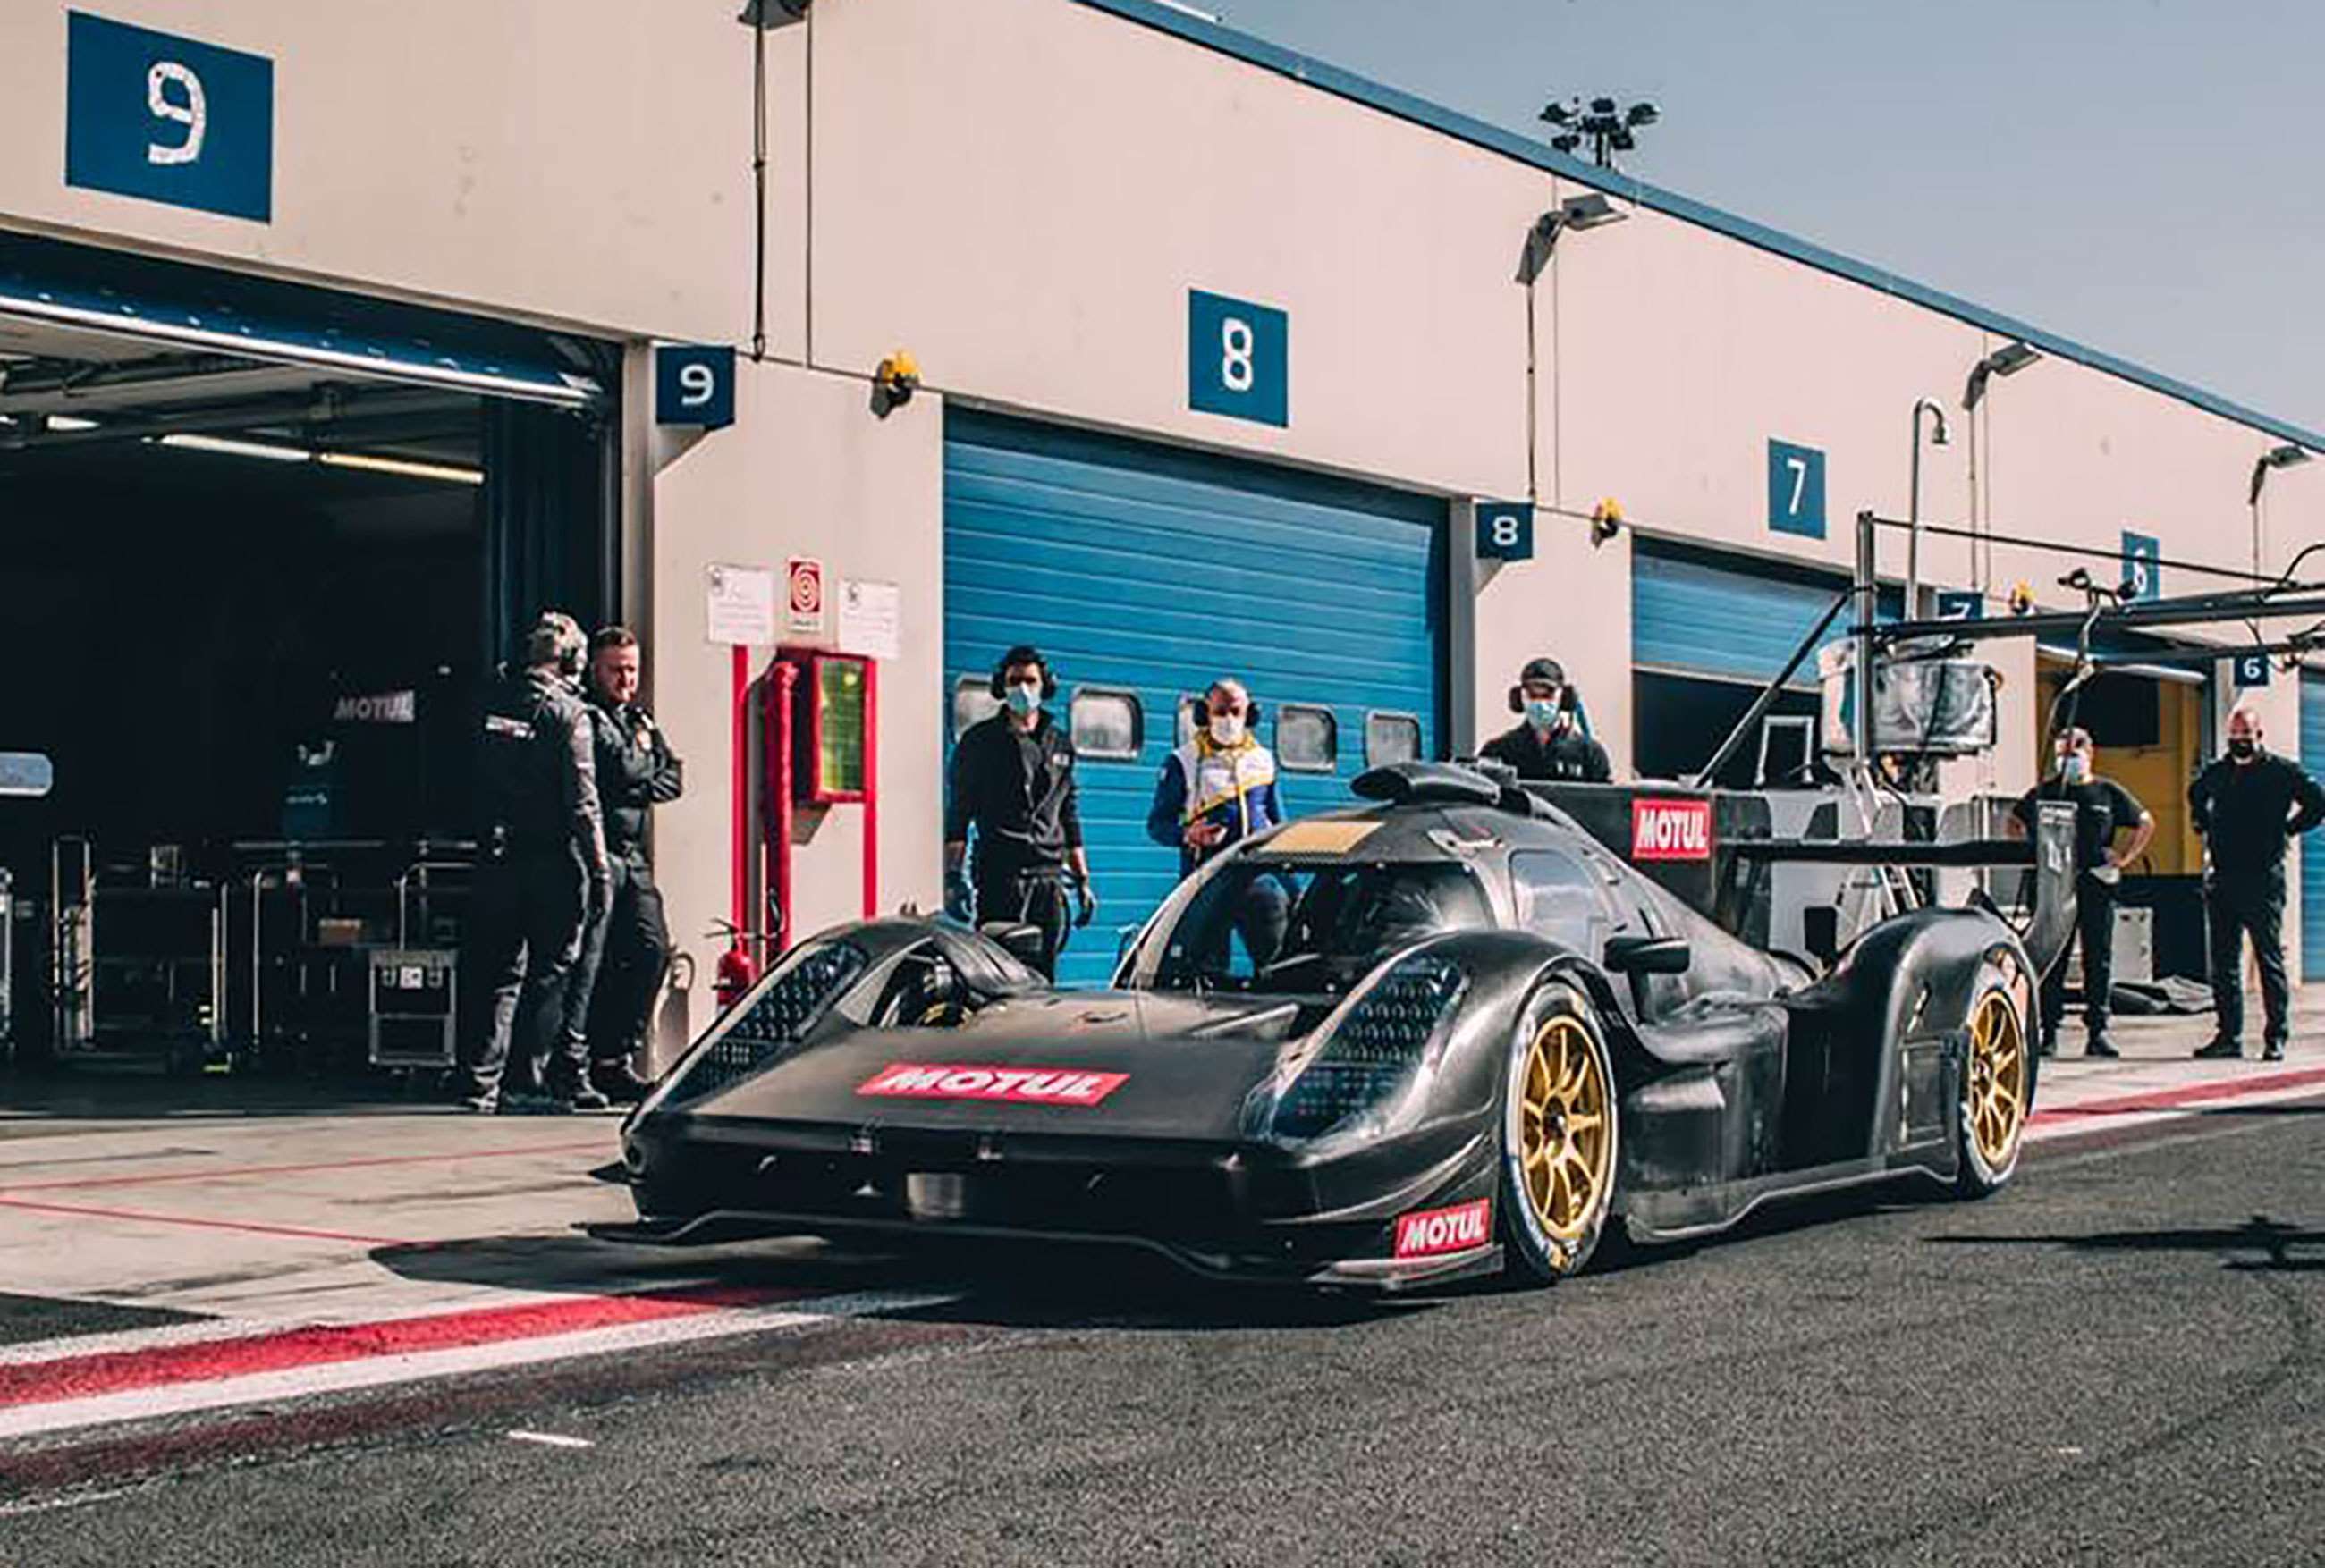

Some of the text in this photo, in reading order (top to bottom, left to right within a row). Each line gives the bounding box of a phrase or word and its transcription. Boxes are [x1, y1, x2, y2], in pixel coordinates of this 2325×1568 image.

[147, 61, 207, 165] 9
[1222, 317, 1254, 392] 8
[680, 364, 714, 406] 9
[1788, 458, 1806, 515] 7
[1492, 515, 1518, 546] 8
[2243, 657, 2262, 679] 6
[1636, 809, 1708, 849] MOTUL
[880, 1067, 1103, 1098] MOTUL
[1399, 1208, 1485, 1253] MOTUL
